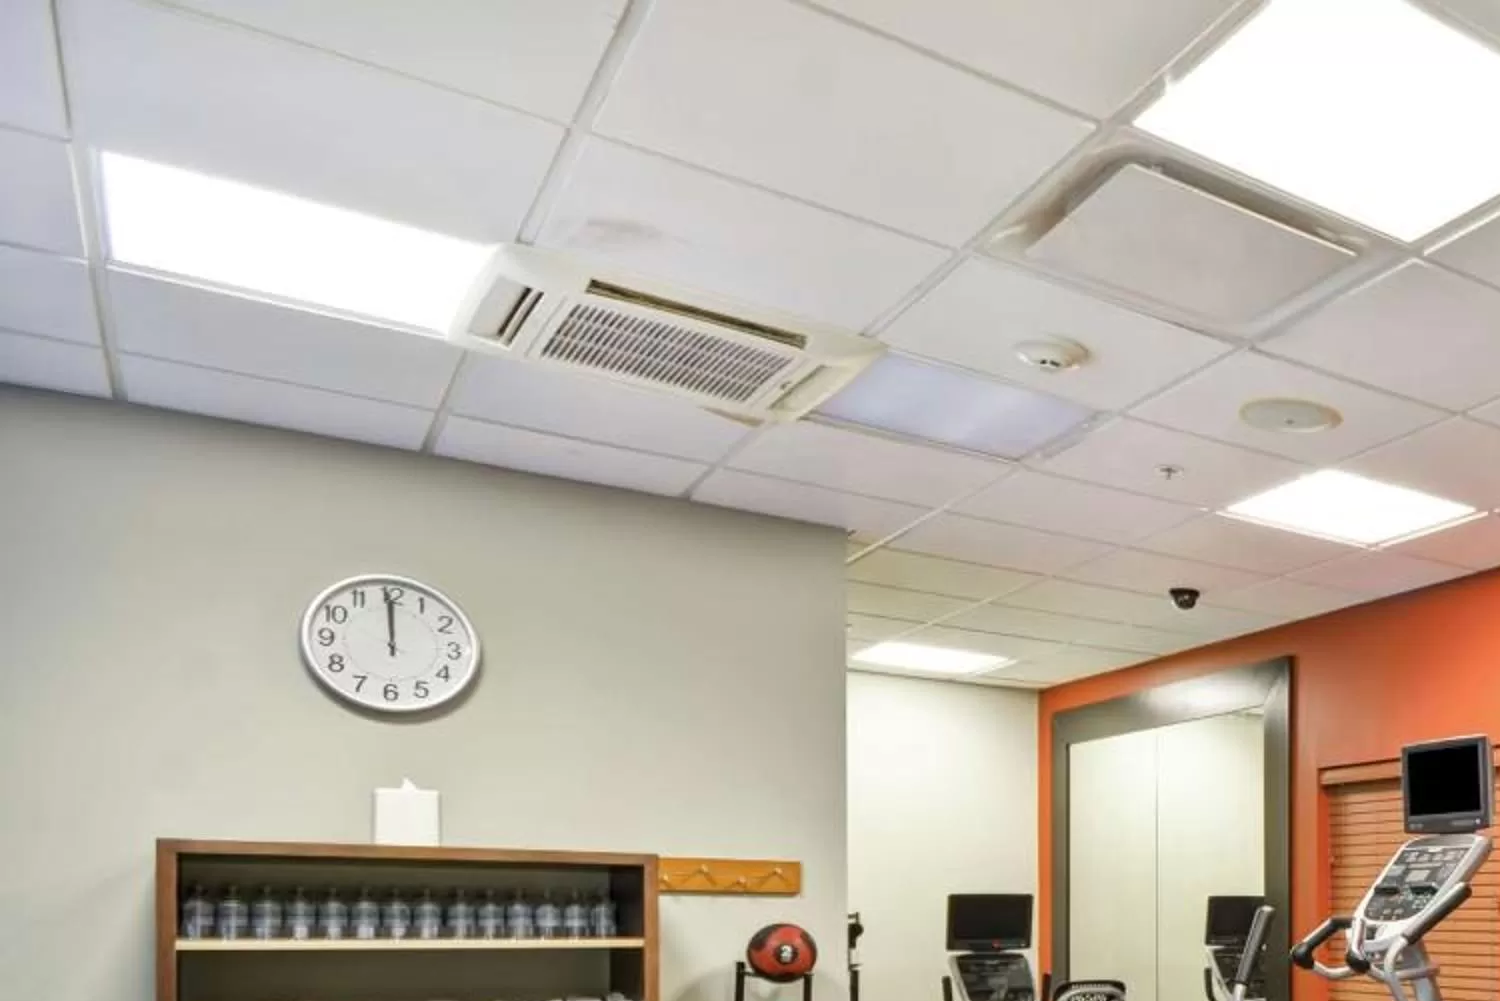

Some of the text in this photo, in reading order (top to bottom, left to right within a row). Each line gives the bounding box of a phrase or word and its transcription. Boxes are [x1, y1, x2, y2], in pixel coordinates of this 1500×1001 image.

[351, 588, 366, 609] 11
[382, 586, 405, 606] 12
[417, 597, 425, 615] 1
[324, 605, 348, 625] 10
[437, 615, 454, 635] 2
[317, 627, 335, 647] 9
[447, 641, 462, 661] 3
[327, 653, 345, 673] 8
[352, 674, 368, 693] 7
[435, 664, 451, 683] 4
[383, 683, 400, 701] 6
[413, 680, 430, 699] 5
